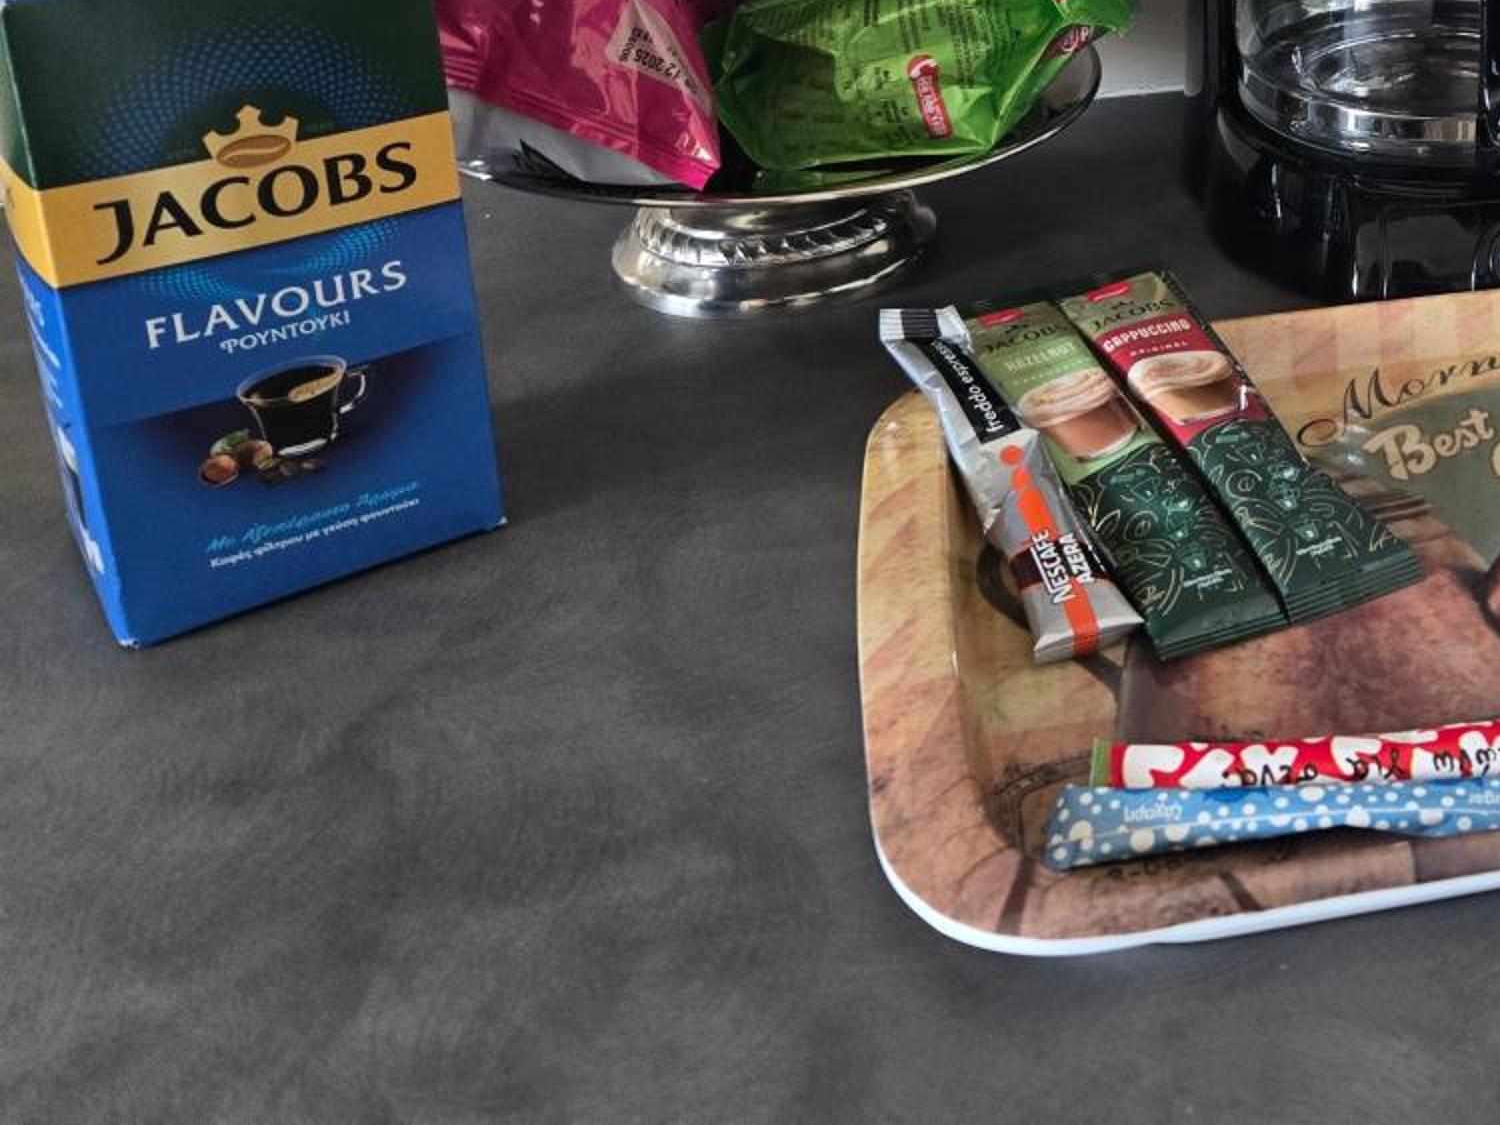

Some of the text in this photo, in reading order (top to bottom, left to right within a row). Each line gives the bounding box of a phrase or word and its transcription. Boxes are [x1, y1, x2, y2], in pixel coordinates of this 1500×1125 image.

[93, 142, 418, 266] JACOBS
[145, 260, 408, 349] FLAVOURS
[1089, 299, 1177, 331] JACOBS
[219, 310, 351, 355] ΦΟΥΝΤΟΥΚΙ
[1103, 317, 1191, 354] CAPPUCCINO
[970, 386, 1005, 433] freddo
[1362, 407, 1496, 481] Best
[1059, 531, 1098, 584] AZERA
